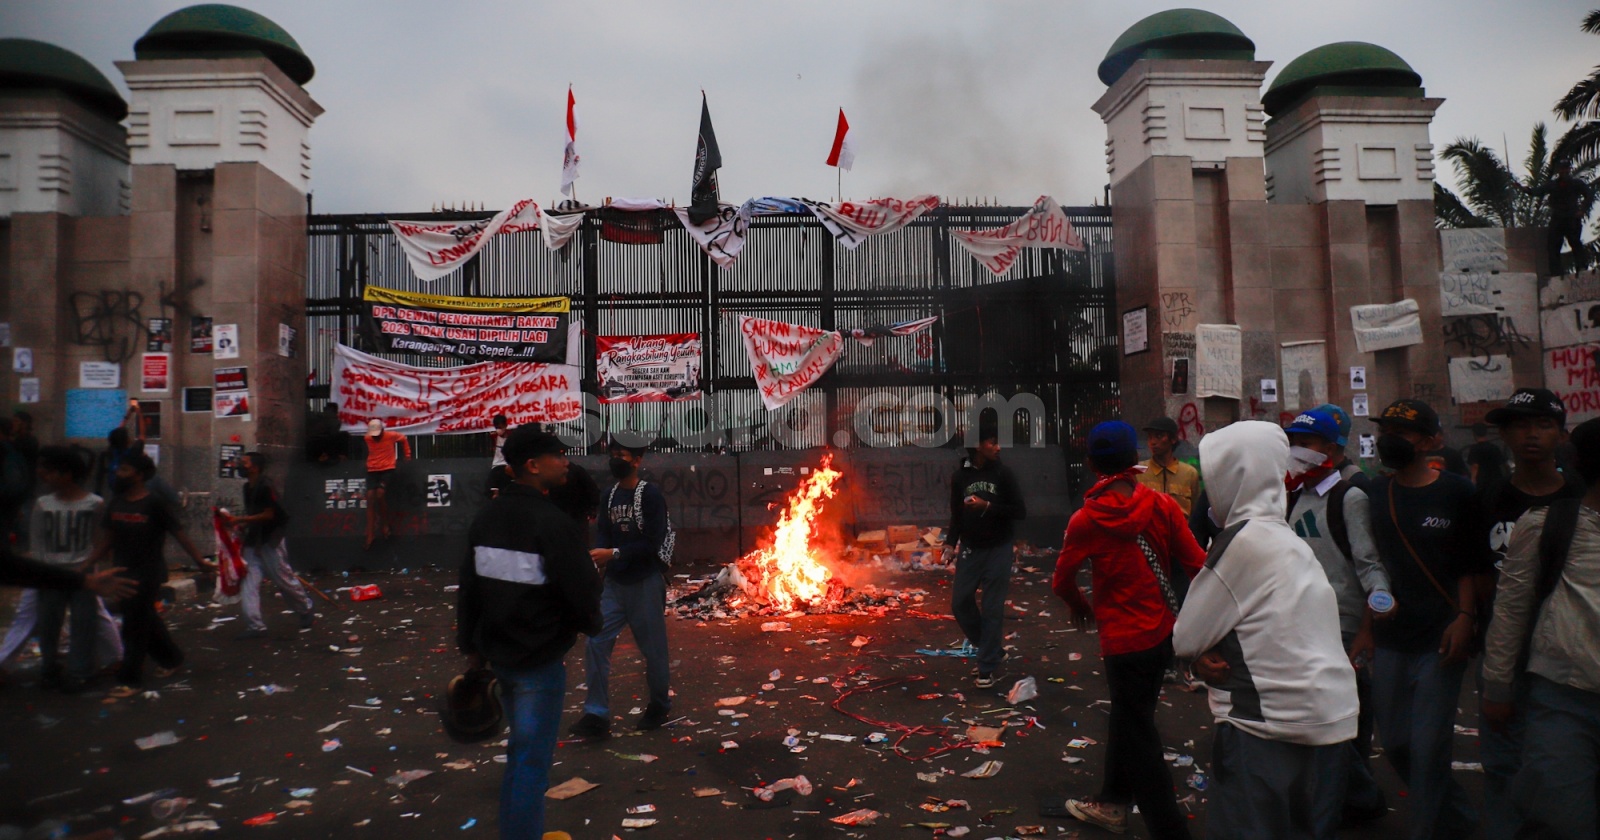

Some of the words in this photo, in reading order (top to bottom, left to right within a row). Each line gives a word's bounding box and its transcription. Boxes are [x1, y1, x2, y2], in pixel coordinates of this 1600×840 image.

[373, 306, 396, 320] DPR
[397, 308, 438, 324] DEWAN
[438, 312, 516, 328] PENGKHIANAT
[517, 316, 559, 329] RAKYAT
[381, 321, 411, 335] 2029
[411, 323, 446, 338] TIDAK
[446, 328, 477, 341] USAH
[478, 329, 520, 343] DIPILIH
[521, 331, 548, 344] LAGI
[391, 337, 456, 353] Karanganyar
[458, 342, 477, 355] Ora
[629, 336, 666, 353] Urang
[753, 338, 802, 360] HUKUM
